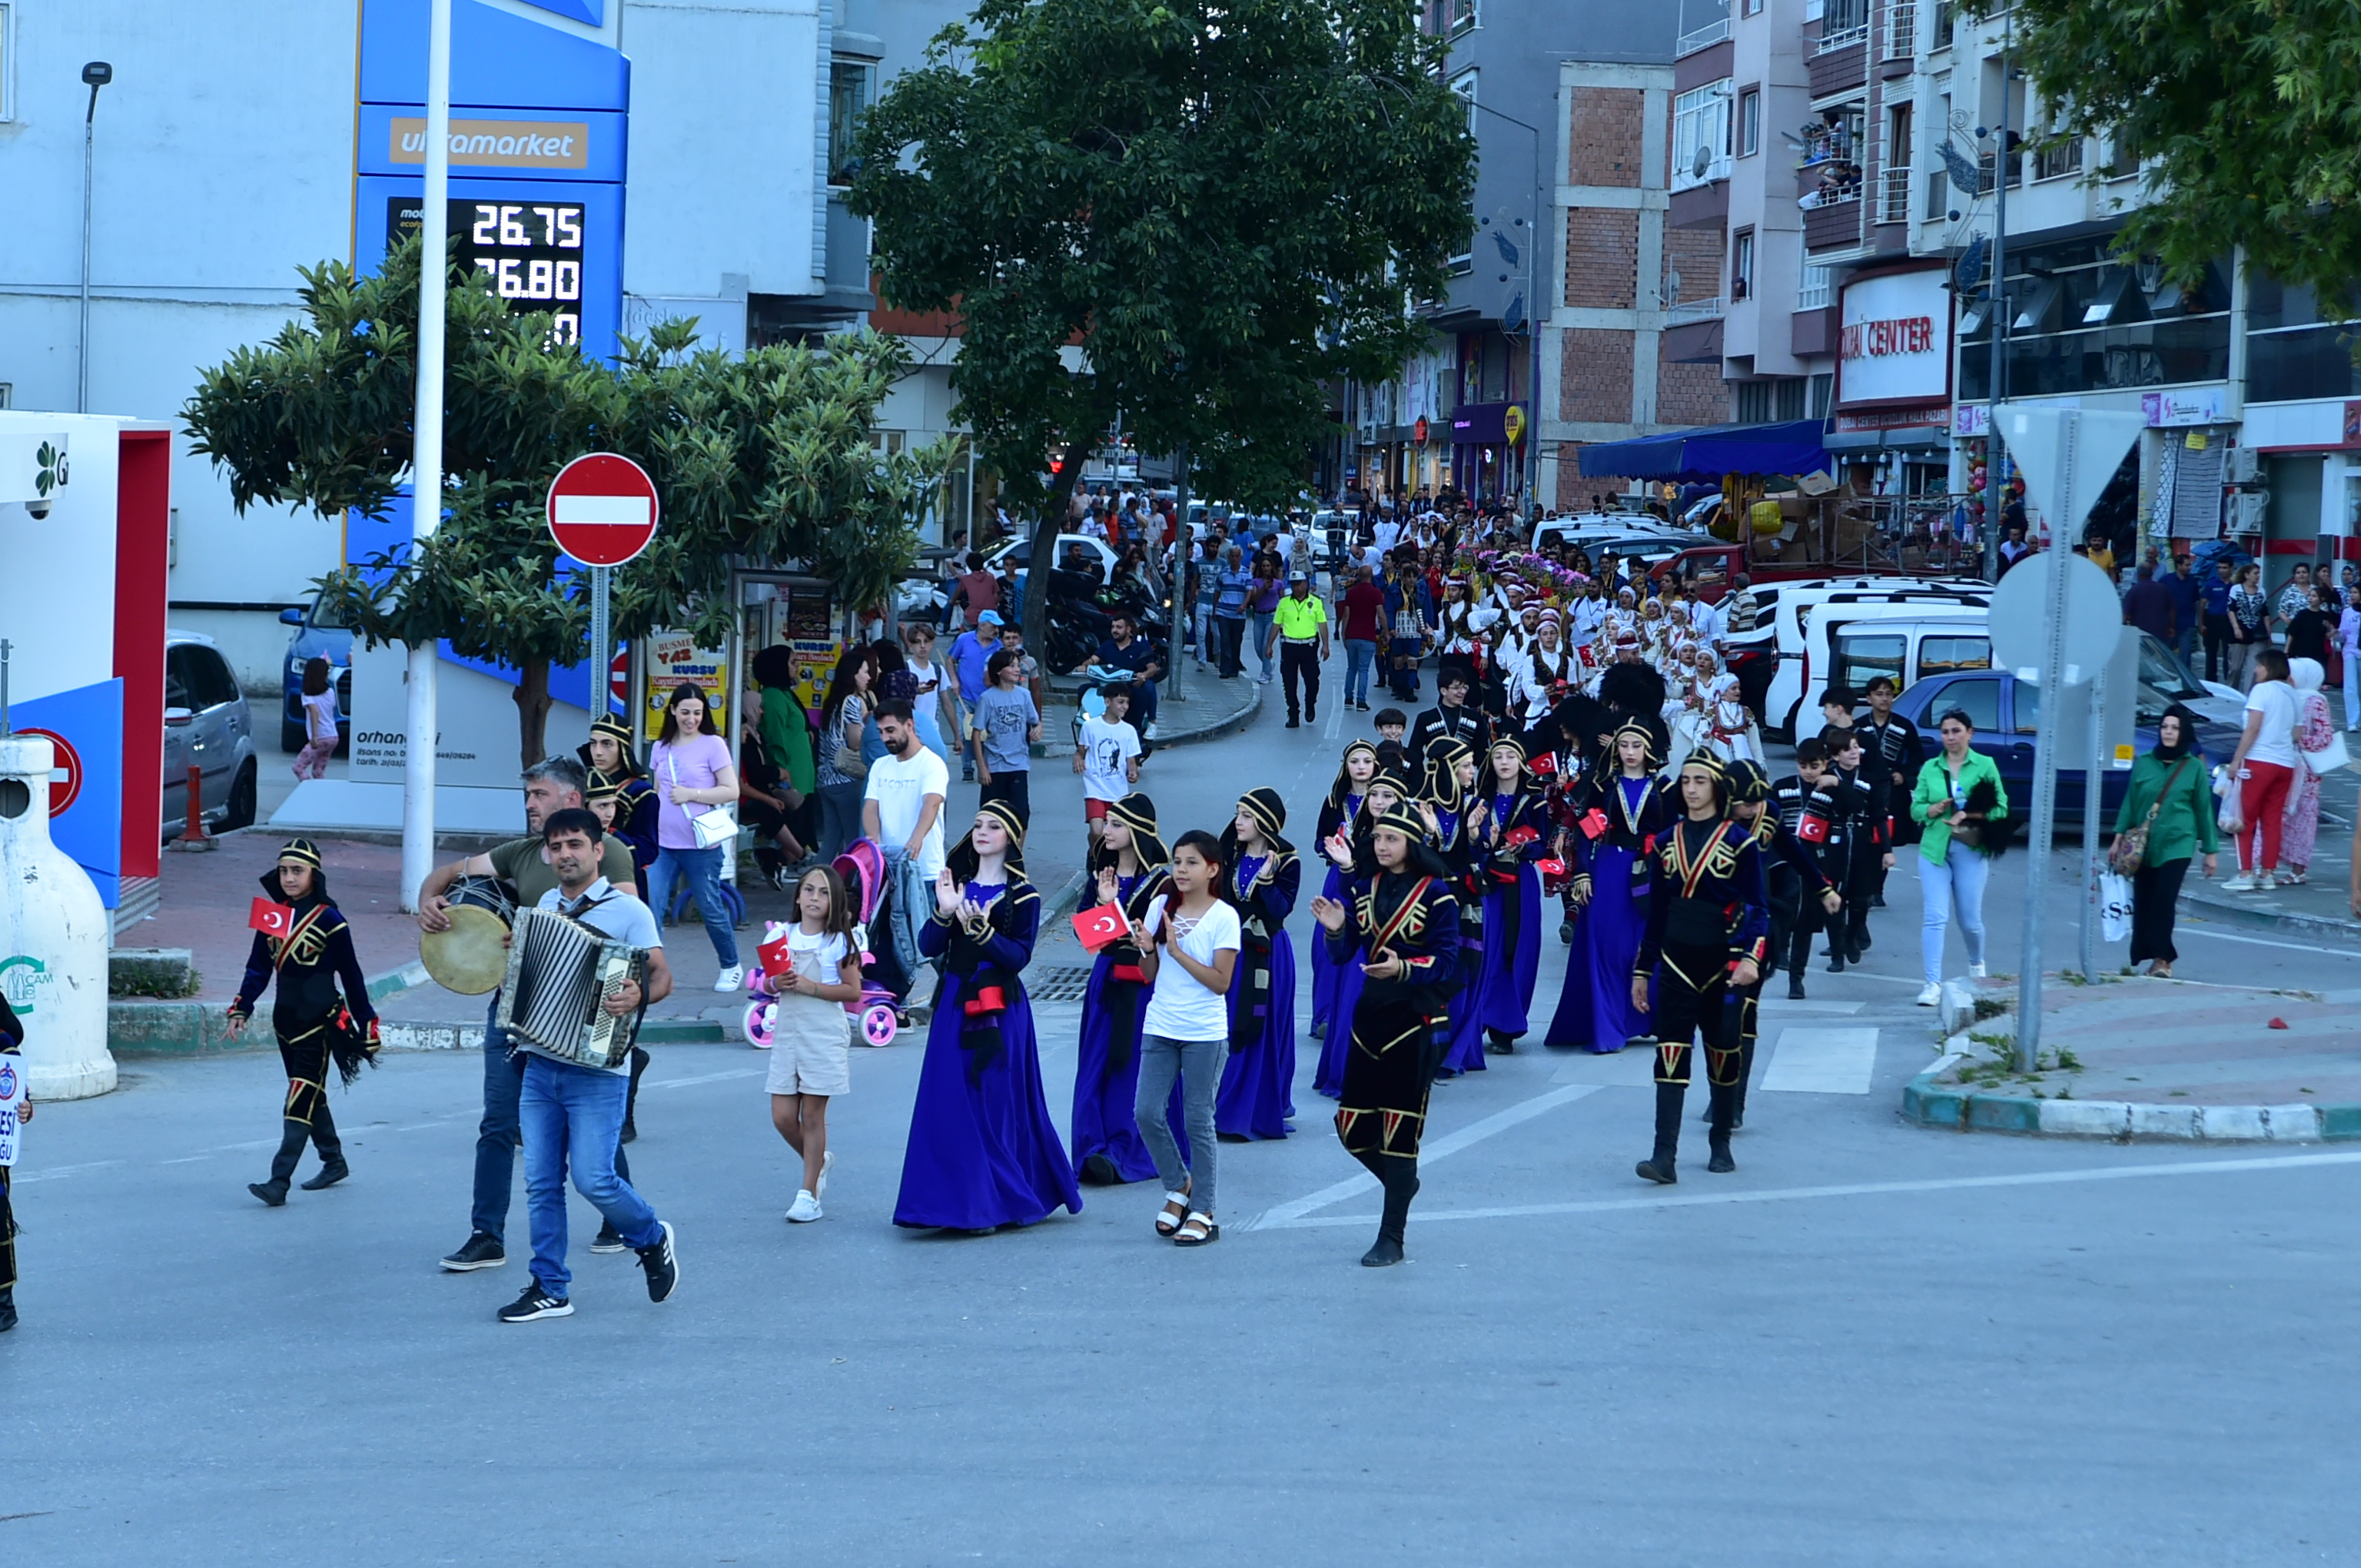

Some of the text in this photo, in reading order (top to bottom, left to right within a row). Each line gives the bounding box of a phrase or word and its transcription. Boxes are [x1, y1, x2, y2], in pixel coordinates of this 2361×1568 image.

[400, 129, 574, 158] ulamarket
[473, 204, 581, 248] 26.75
[1868, 316, 1933, 356] CENTER
[794, 642, 835, 652] KURSU
[657, 648, 692, 665] YAZ
[672, 665, 717, 675] KURSU
[357, 731, 441, 749] orhani
[25, 974, 54, 985] CAM
